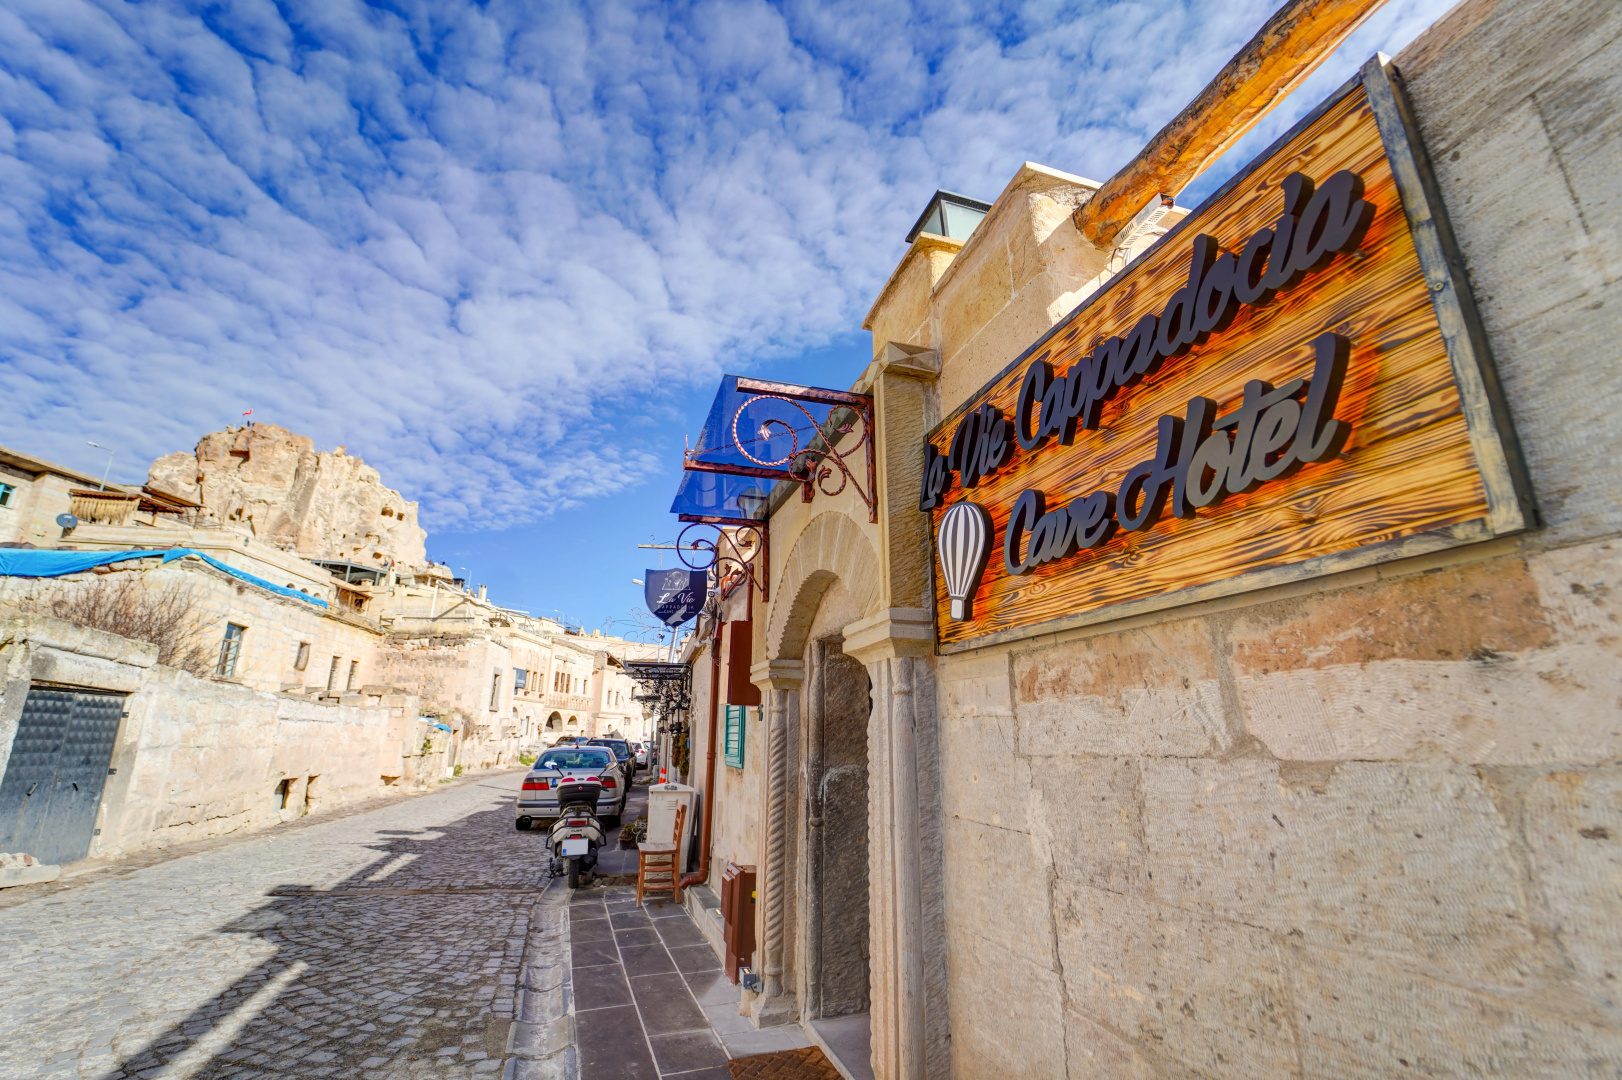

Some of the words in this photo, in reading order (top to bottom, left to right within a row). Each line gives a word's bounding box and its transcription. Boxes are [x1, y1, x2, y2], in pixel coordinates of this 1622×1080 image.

[919, 443, 947, 512] La
[948, 402, 1013, 490] Vie
[1016, 171, 1368, 451] Cappadocia
[1004, 488, 1113, 577] Cave
[1116, 331, 1346, 532] Hotel
[656, 592, 675, 604] La
[677, 591, 695, 604] Vie
